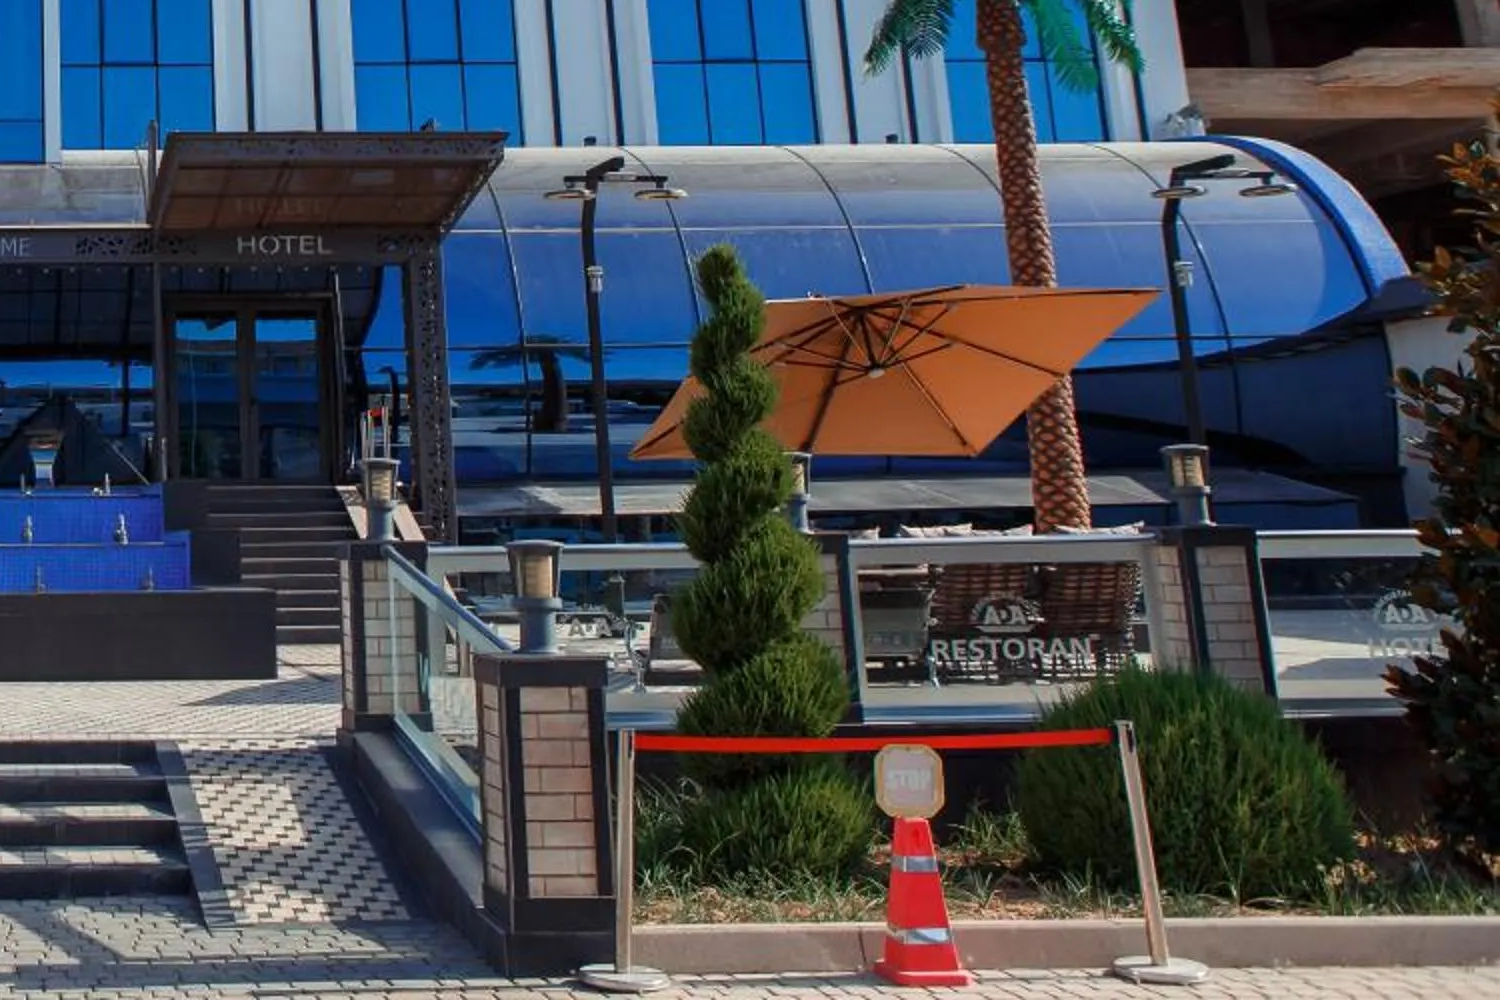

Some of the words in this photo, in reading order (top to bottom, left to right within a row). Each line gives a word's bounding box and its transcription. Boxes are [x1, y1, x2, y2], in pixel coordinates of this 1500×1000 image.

[237, 235, 334, 255] HOTEL
[931, 637, 1093, 663] RESTORAN
[886, 768, 933, 791] STOP
